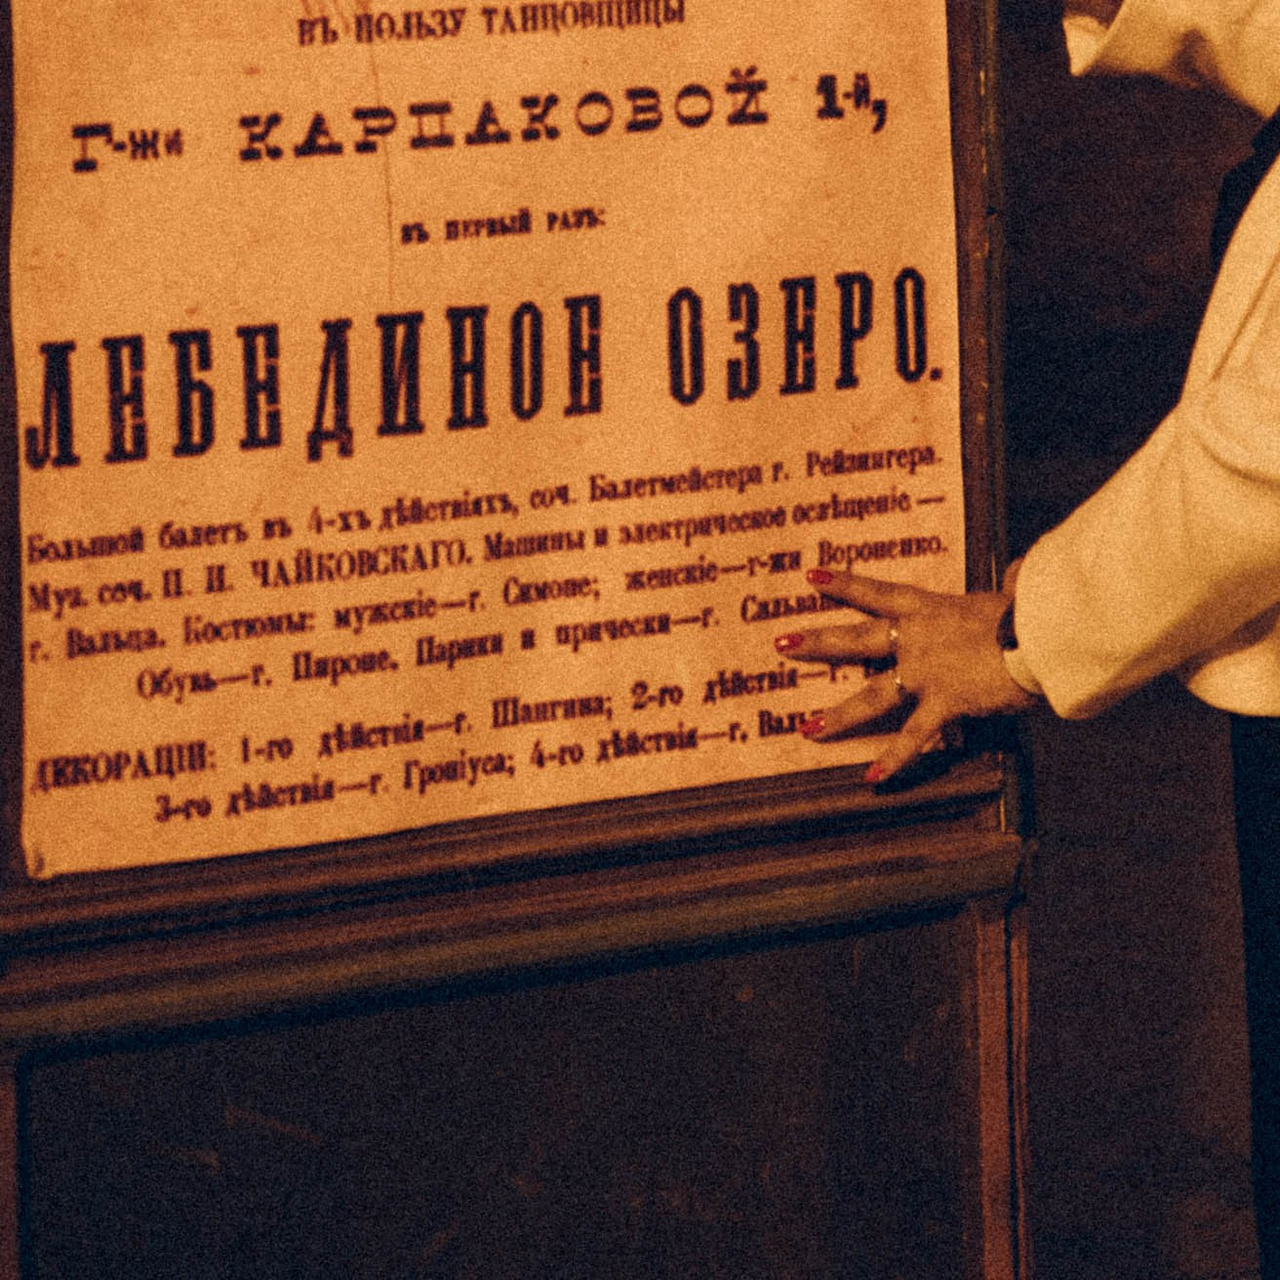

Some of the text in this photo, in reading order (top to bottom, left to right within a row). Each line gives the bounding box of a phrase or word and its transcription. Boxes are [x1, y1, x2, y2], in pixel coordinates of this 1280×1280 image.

[354, 5, 468, 45] ПОЛЬЗУ
[237, 63, 770, 163] КАРПАКОВОЙ
[24, 266, 945, 470] ЛЕБЕДИНОЕ ОЗЕРО.
[26, 525, 146, 565] Большой
[158, 519, 250, 552] балетъ
[262, 516, 294, 541] въ
[588, 463, 764, 504] Балетмейстера
[249, 538, 474, 591] ЧАЙКОВСКАГО.
[483, 530, 586, 562] Машины
[593, 525, 610, 549] и
[183, 611, 316, 646] Костюмы:
[416, 632, 504, 671] Парики
[520, 627, 537, 651] и
[240, 735, 295, 765] 1-го
[630, 680, 686, 711] 2-го
[154, 793, 212, 824] 3-го
[530, 738, 585, 769] 4-го
